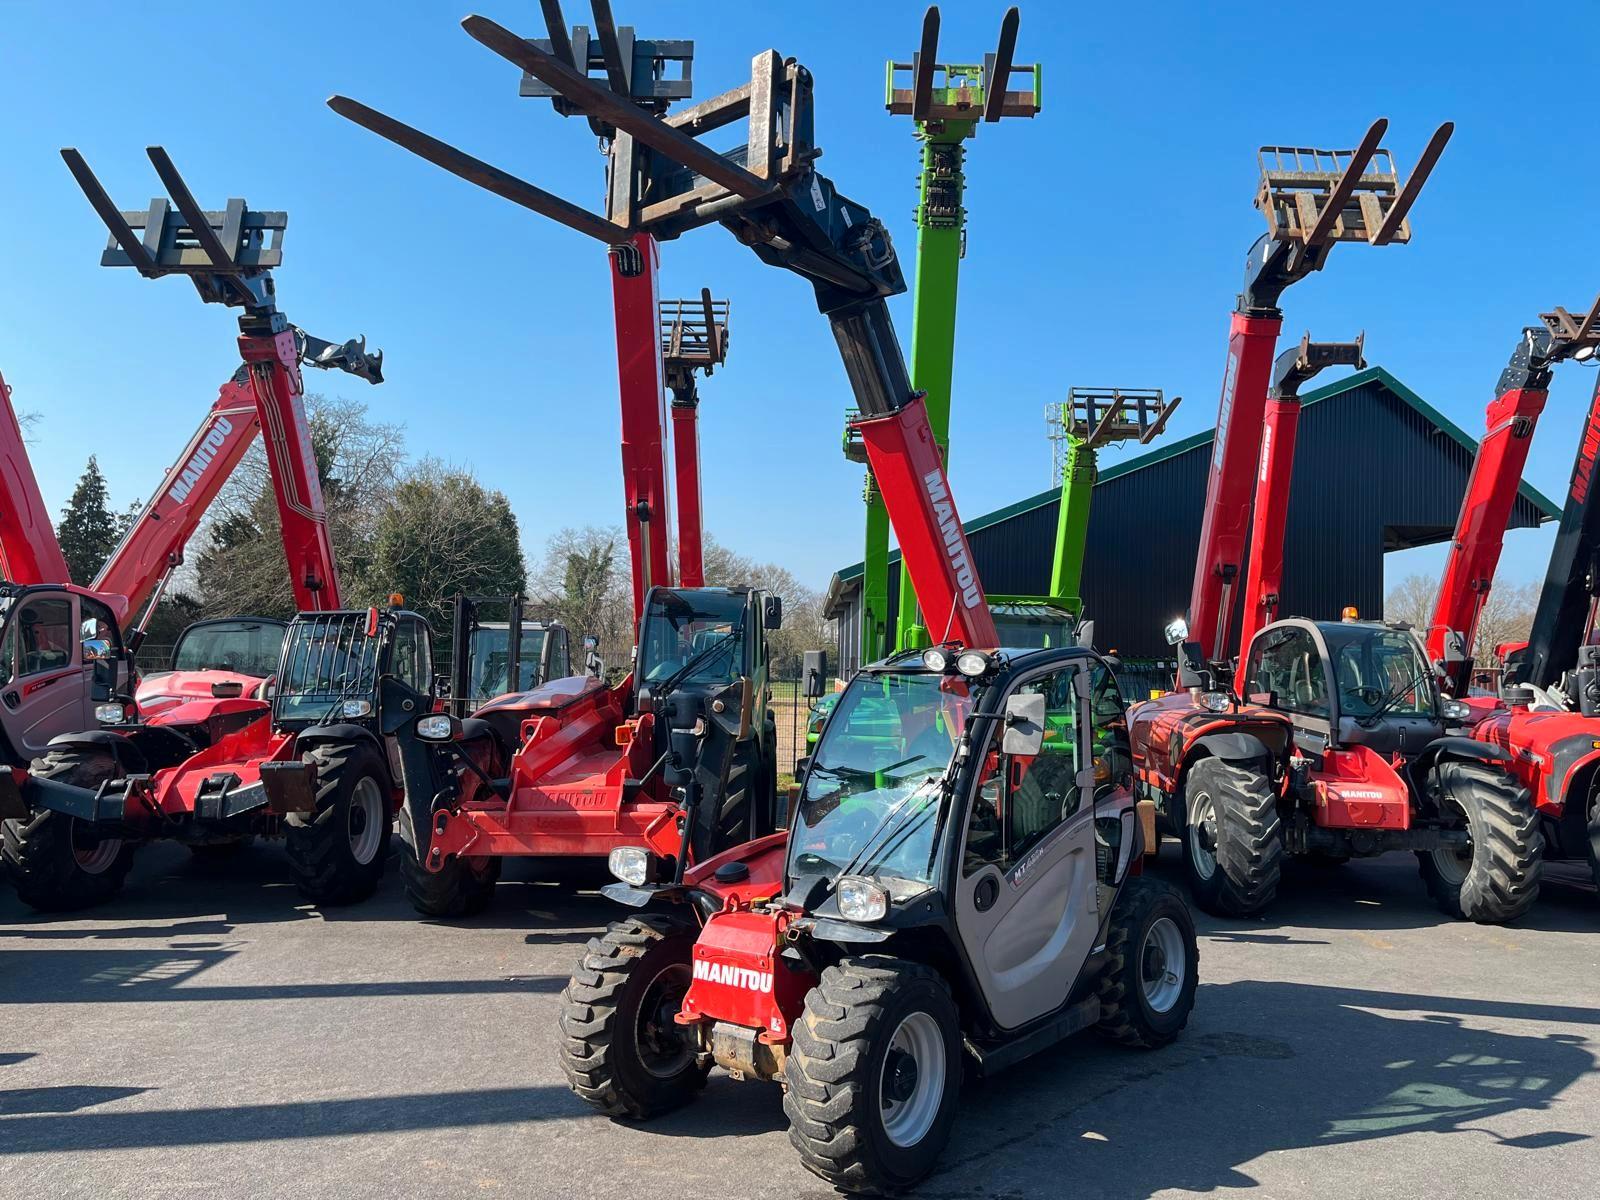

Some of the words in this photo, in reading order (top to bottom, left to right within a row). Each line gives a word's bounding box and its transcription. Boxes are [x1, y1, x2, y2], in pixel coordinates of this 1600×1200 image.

[1213, 351, 1238, 471] MANITOU
[168, 416, 233, 504] MANITOU
[923, 467, 982, 609] MANITOU
[1340, 790, 1383, 799] MANITOU
[693, 959, 774, 993] MANITOU
